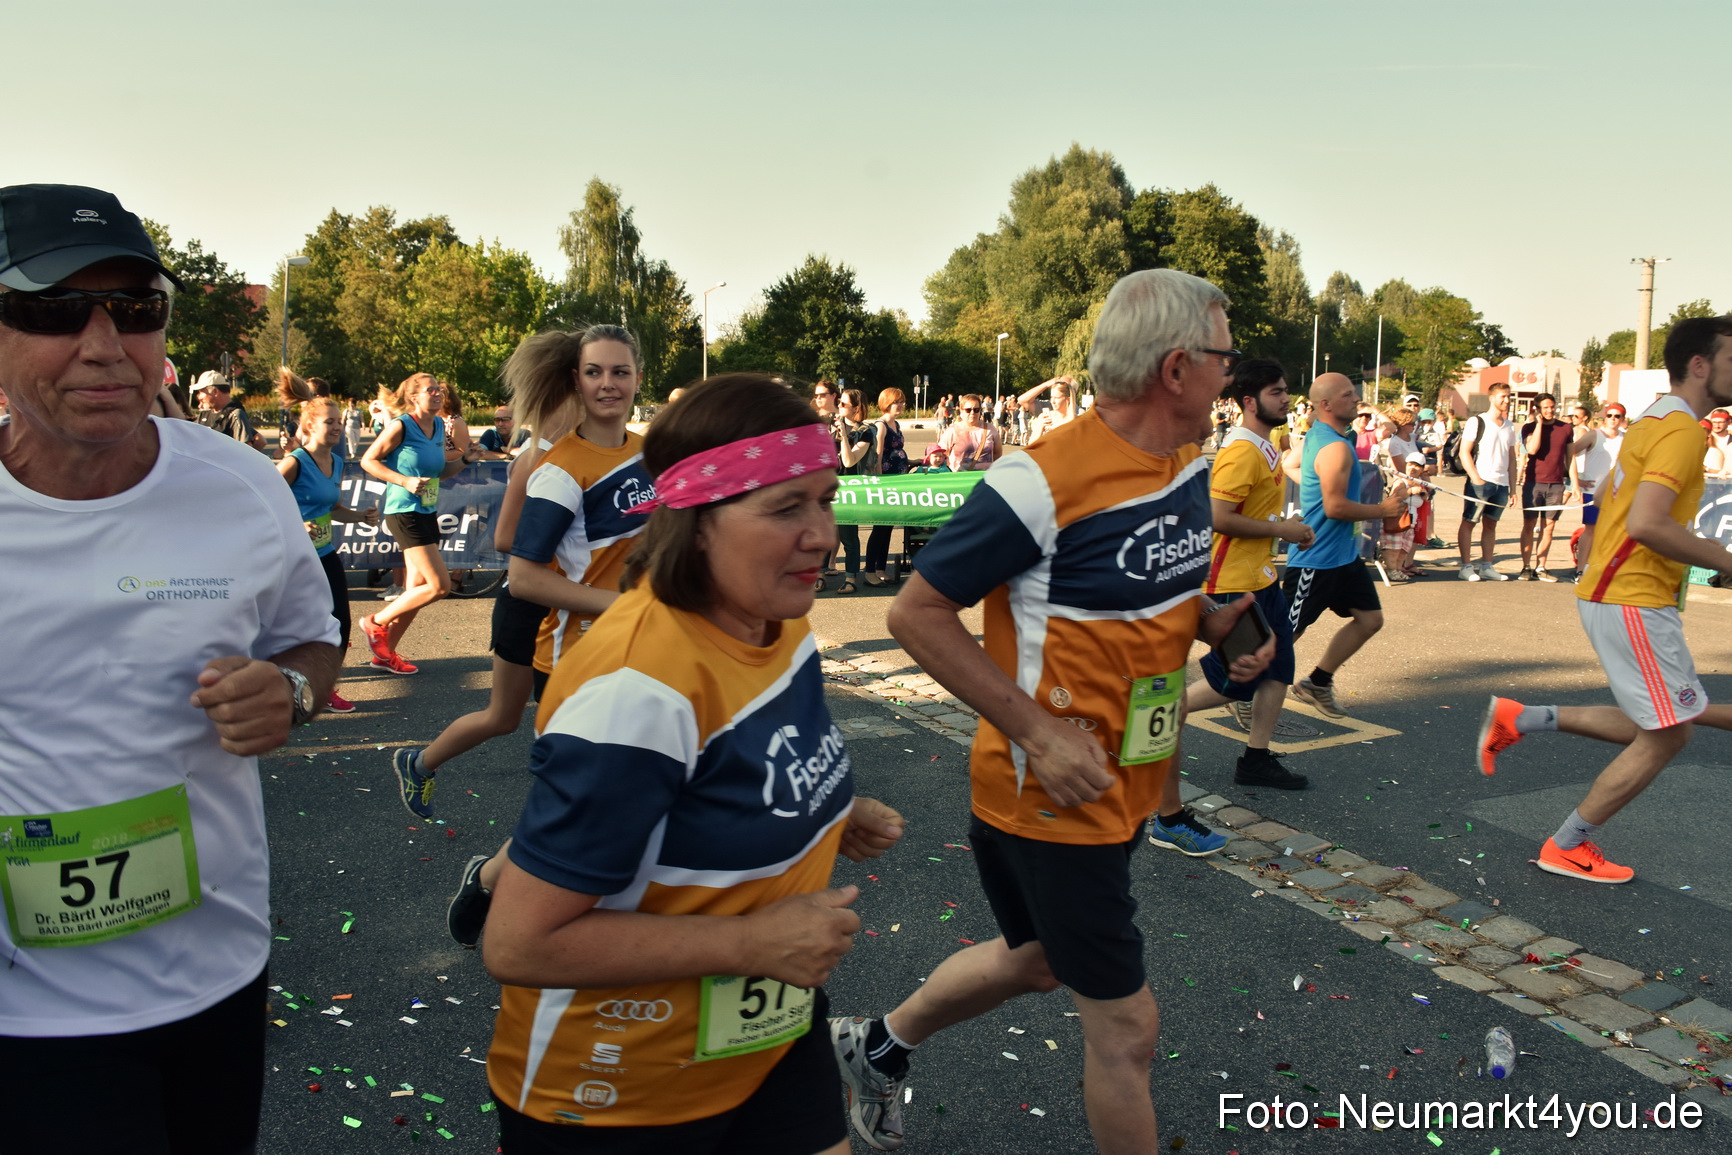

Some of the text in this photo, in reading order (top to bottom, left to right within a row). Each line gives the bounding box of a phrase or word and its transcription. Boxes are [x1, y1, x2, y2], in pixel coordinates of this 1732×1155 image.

[866, 488, 964, 508] Händen
[336, 539, 466, 555] AUTOMILE
[145, 580, 167, 588] DAS
[146, 588, 230, 601] ORTHOPÄDIE
[60, 850, 130, 907] 57
[35, 912, 56, 925] Dr.
[59, 908, 96, 924] Bärtl
[100, 888, 171, 917] Wolfgang
[38, 925, 61, 936] BAG
[105, 914, 126, 928] und
[127, 901, 170, 920] Kollegen
[592, 1021, 627, 1033] Audi
